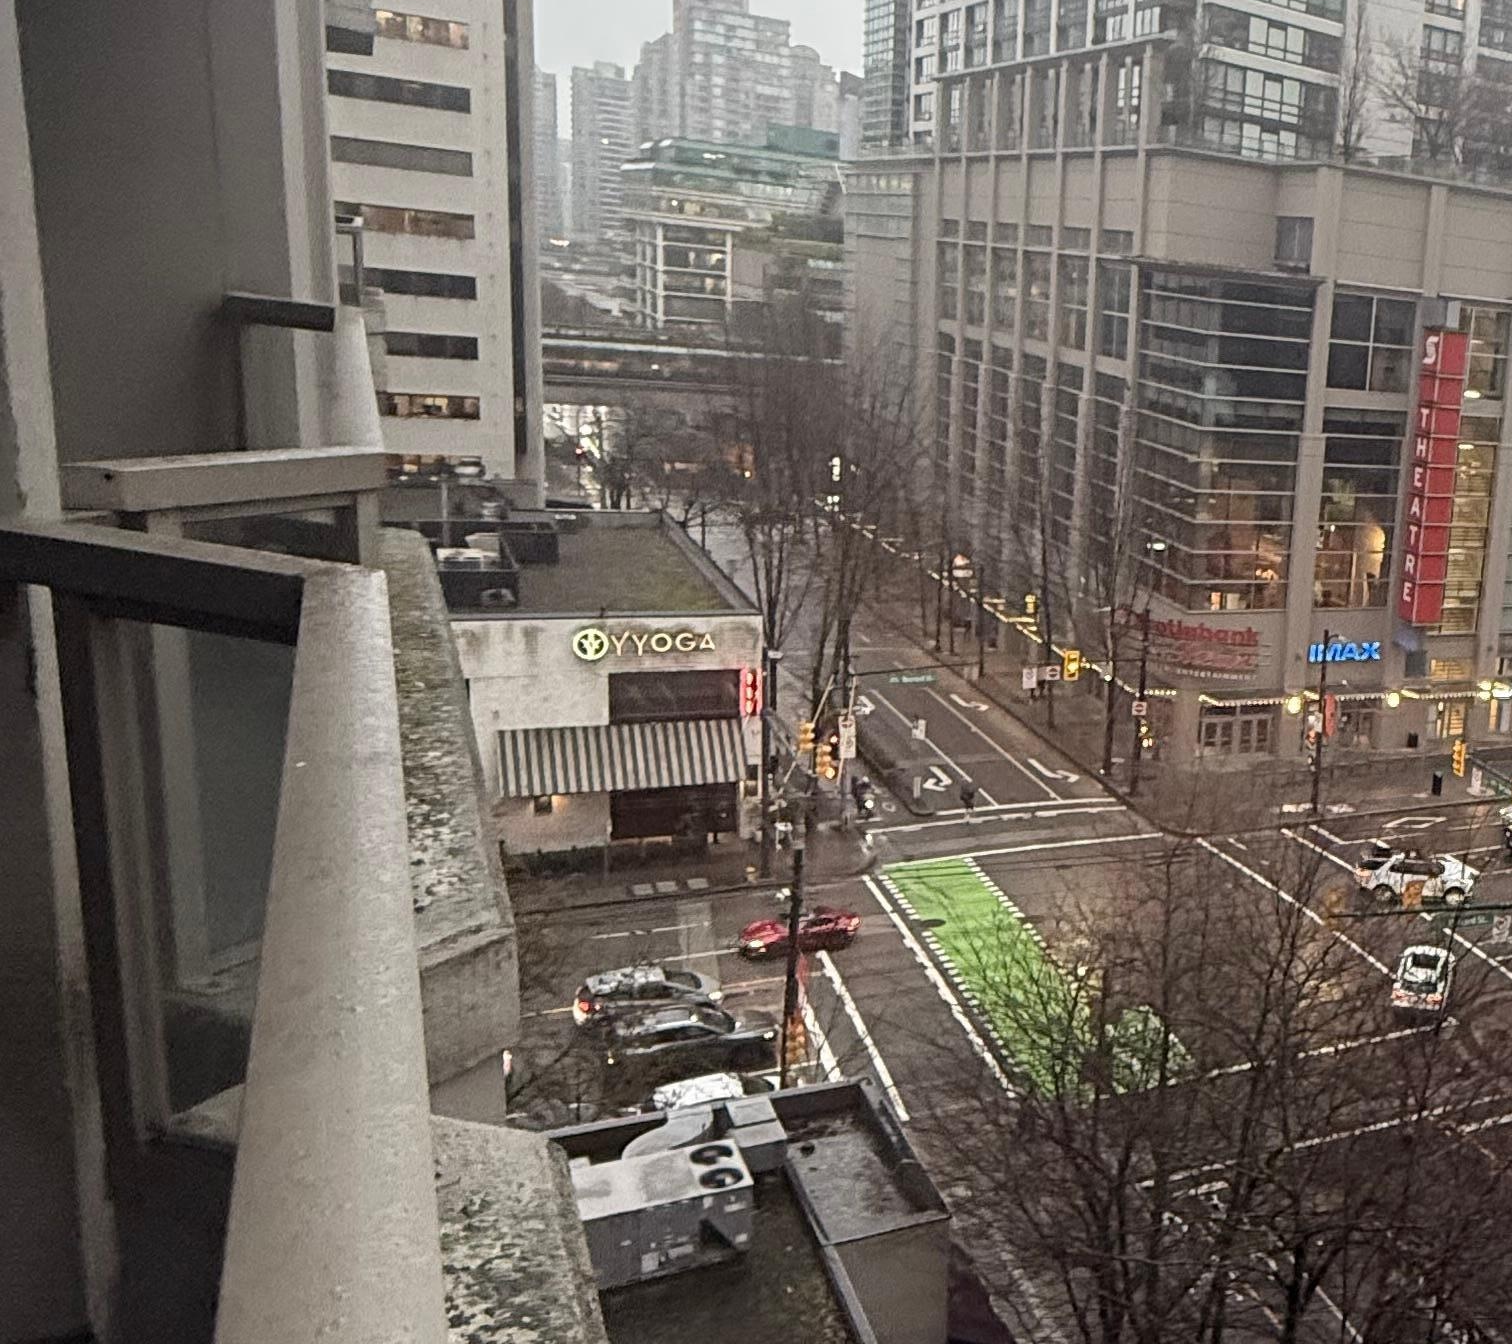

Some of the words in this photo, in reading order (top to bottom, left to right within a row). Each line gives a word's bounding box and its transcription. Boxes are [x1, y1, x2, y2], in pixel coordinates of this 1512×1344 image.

[1403, 408, 1430, 602] THEATRE
[610, 631, 715, 656] YYOGA
[1309, 641, 1381, 663] IMAX
